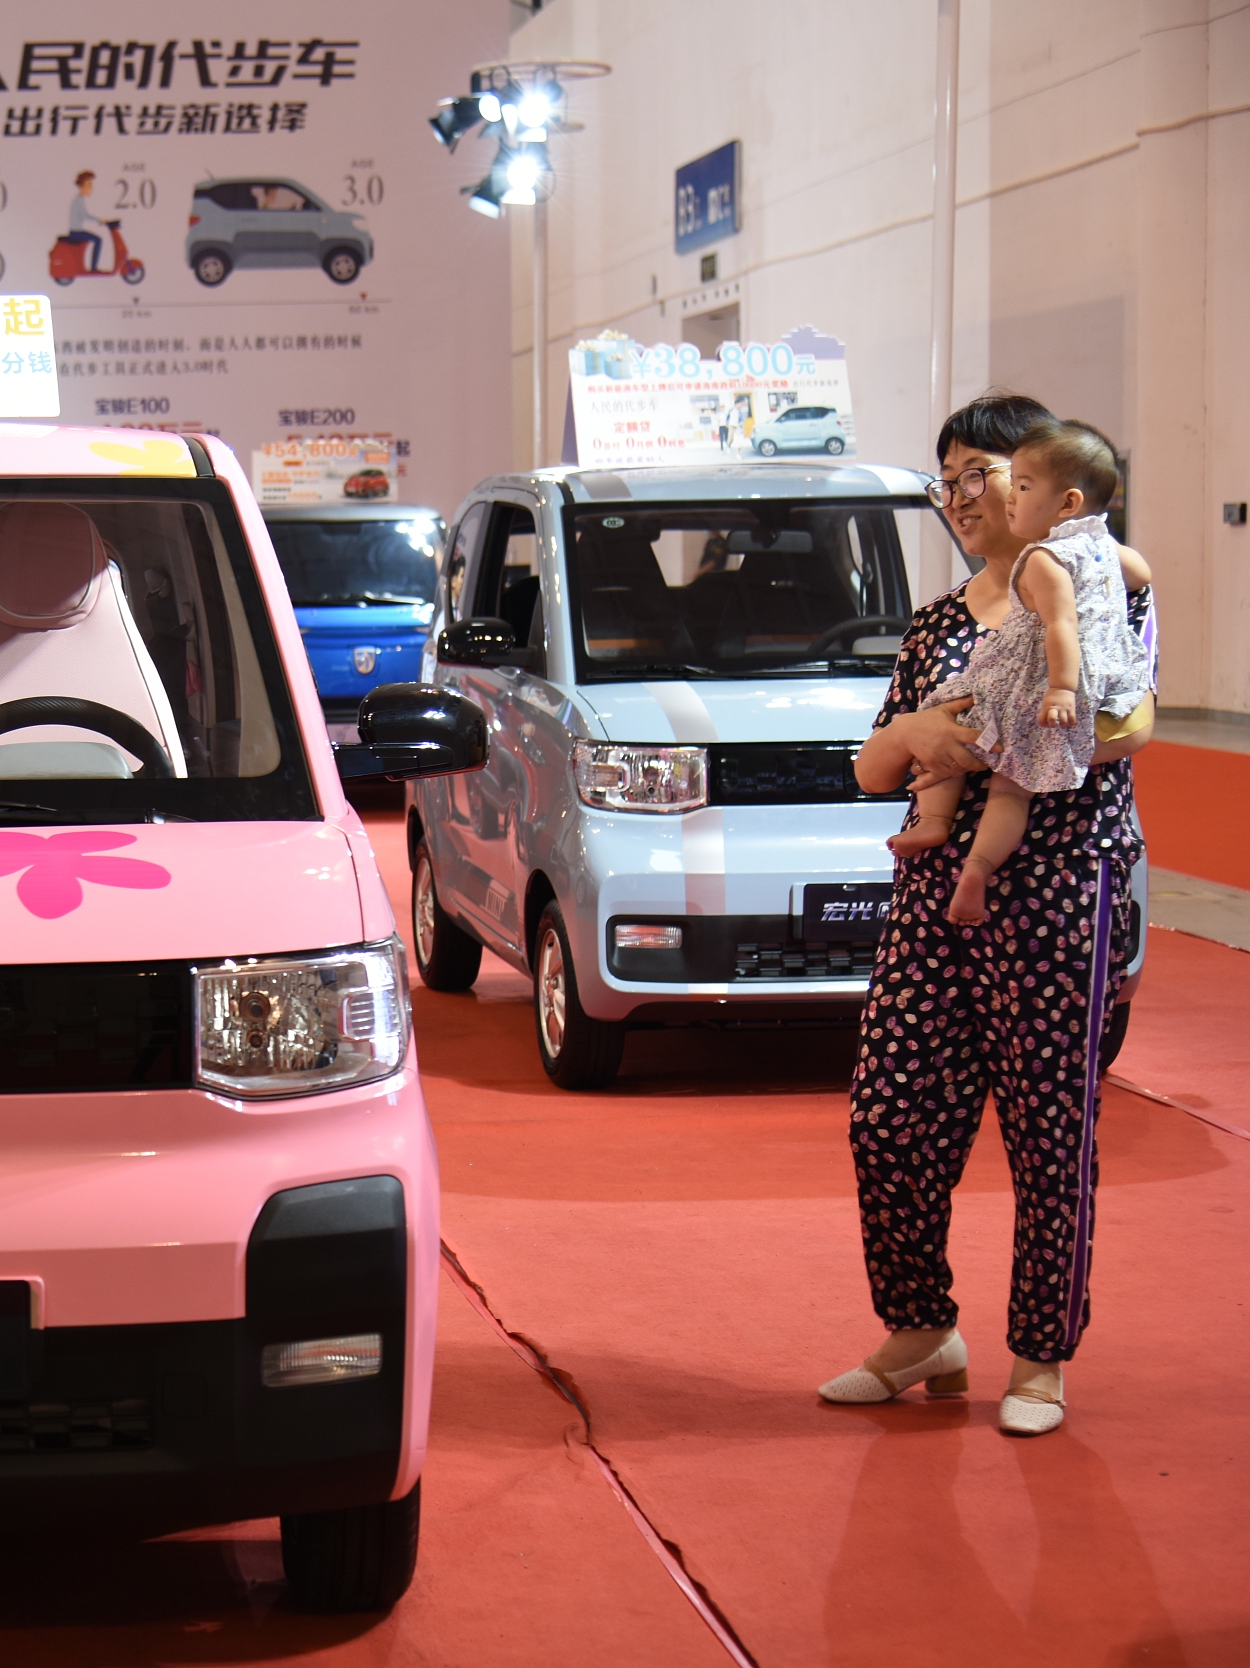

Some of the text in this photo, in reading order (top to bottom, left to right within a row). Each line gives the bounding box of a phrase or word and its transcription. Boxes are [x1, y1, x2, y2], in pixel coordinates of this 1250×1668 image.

[3, 101, 309, 137] 出行代步新选择
[114, 178, 157, 211] 2.0
[341, 174, 385, 207] 3.0
[95, 397, 171, 416] 宝骏E100
[589, 398, 659, 414] 人民的代步车
[278, 408, 356, 427] 宝骏E200
[820, 901, 874, 922] 宏光
